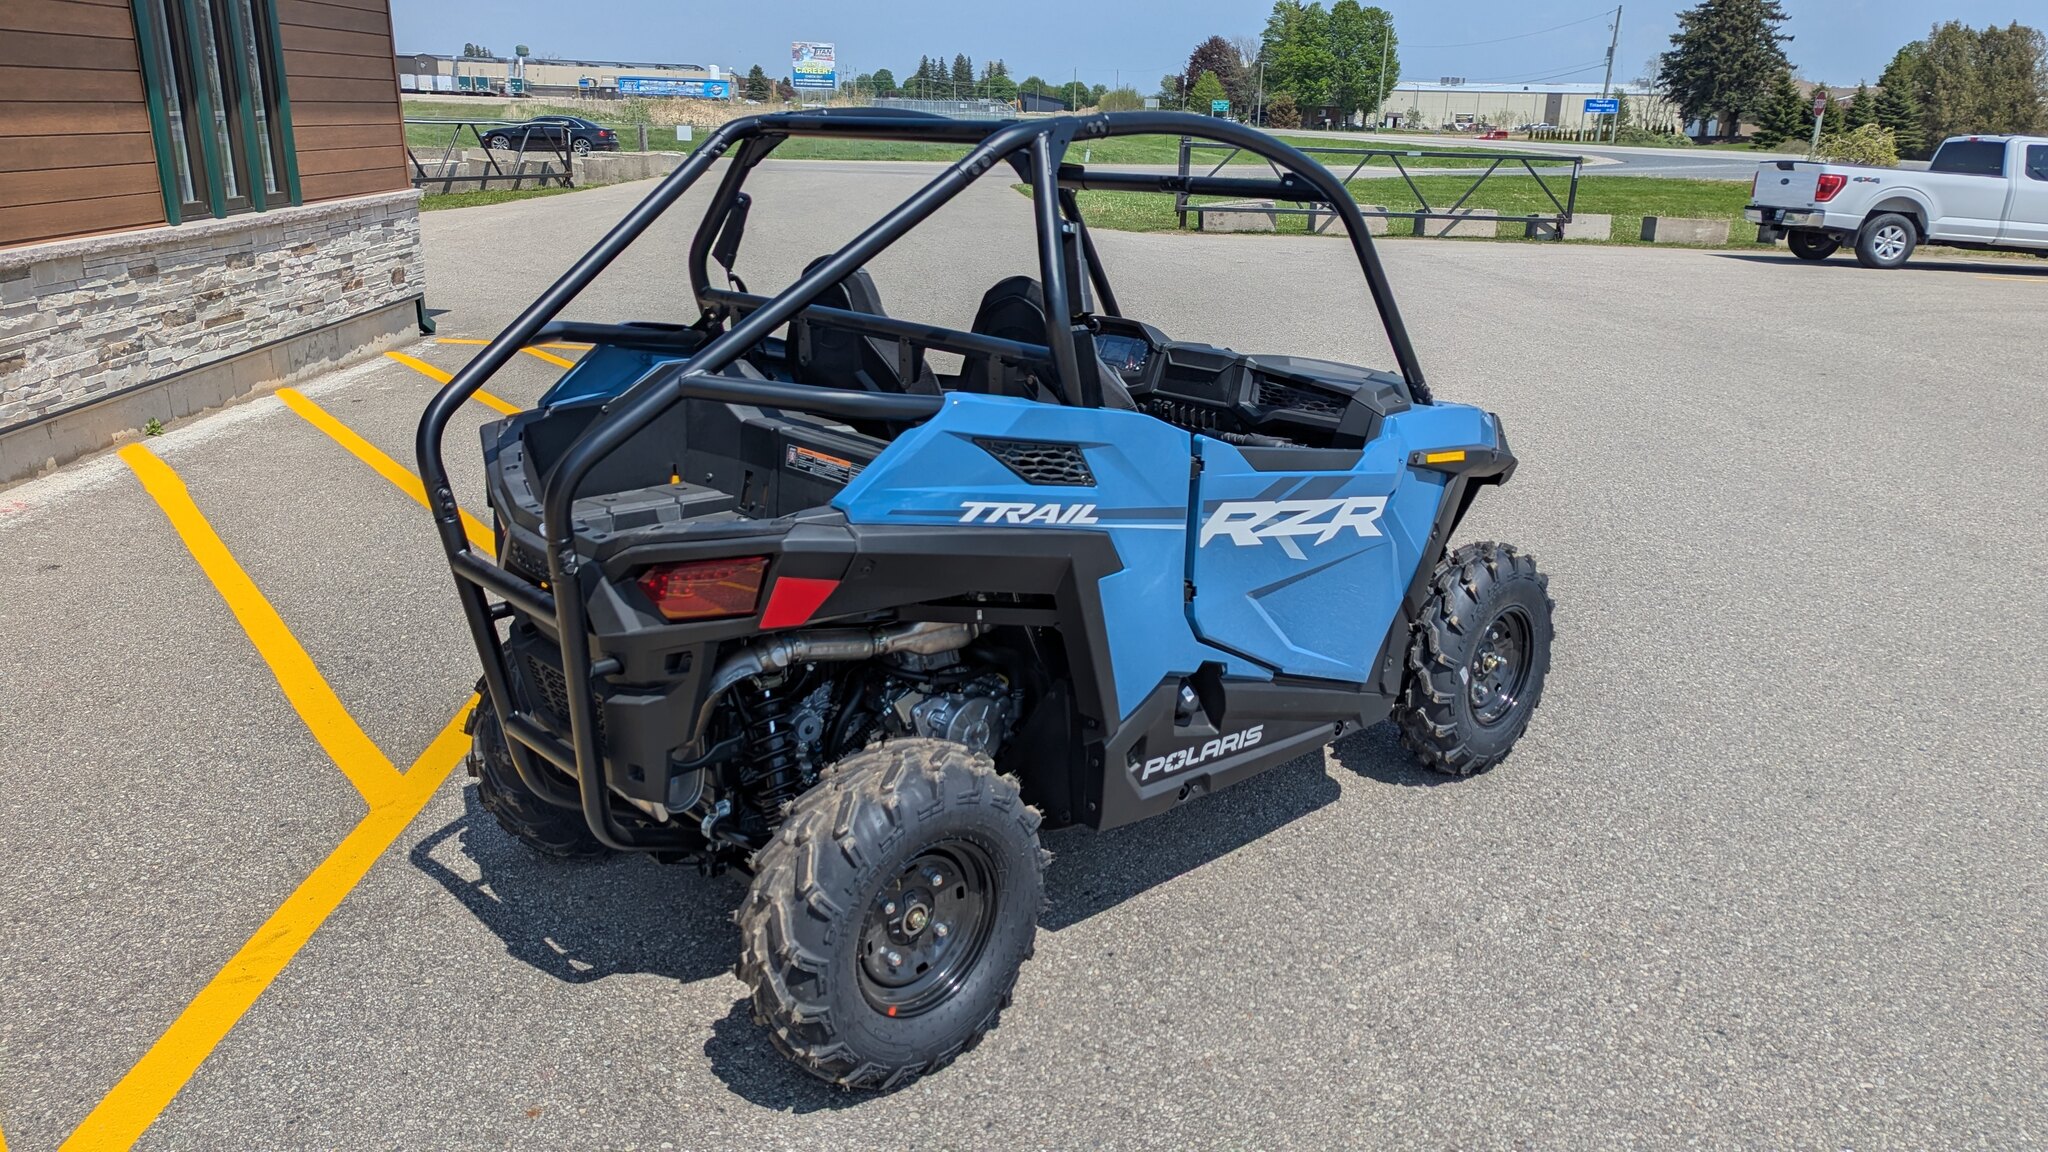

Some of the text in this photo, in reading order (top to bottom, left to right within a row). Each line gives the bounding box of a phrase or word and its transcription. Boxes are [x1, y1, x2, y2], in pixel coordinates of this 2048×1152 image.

[958, 501, 1098, 524] TRAIL
[1199, 496, 1388, 549] RZR
[1142, 724, 1264, 781] POLARIS
